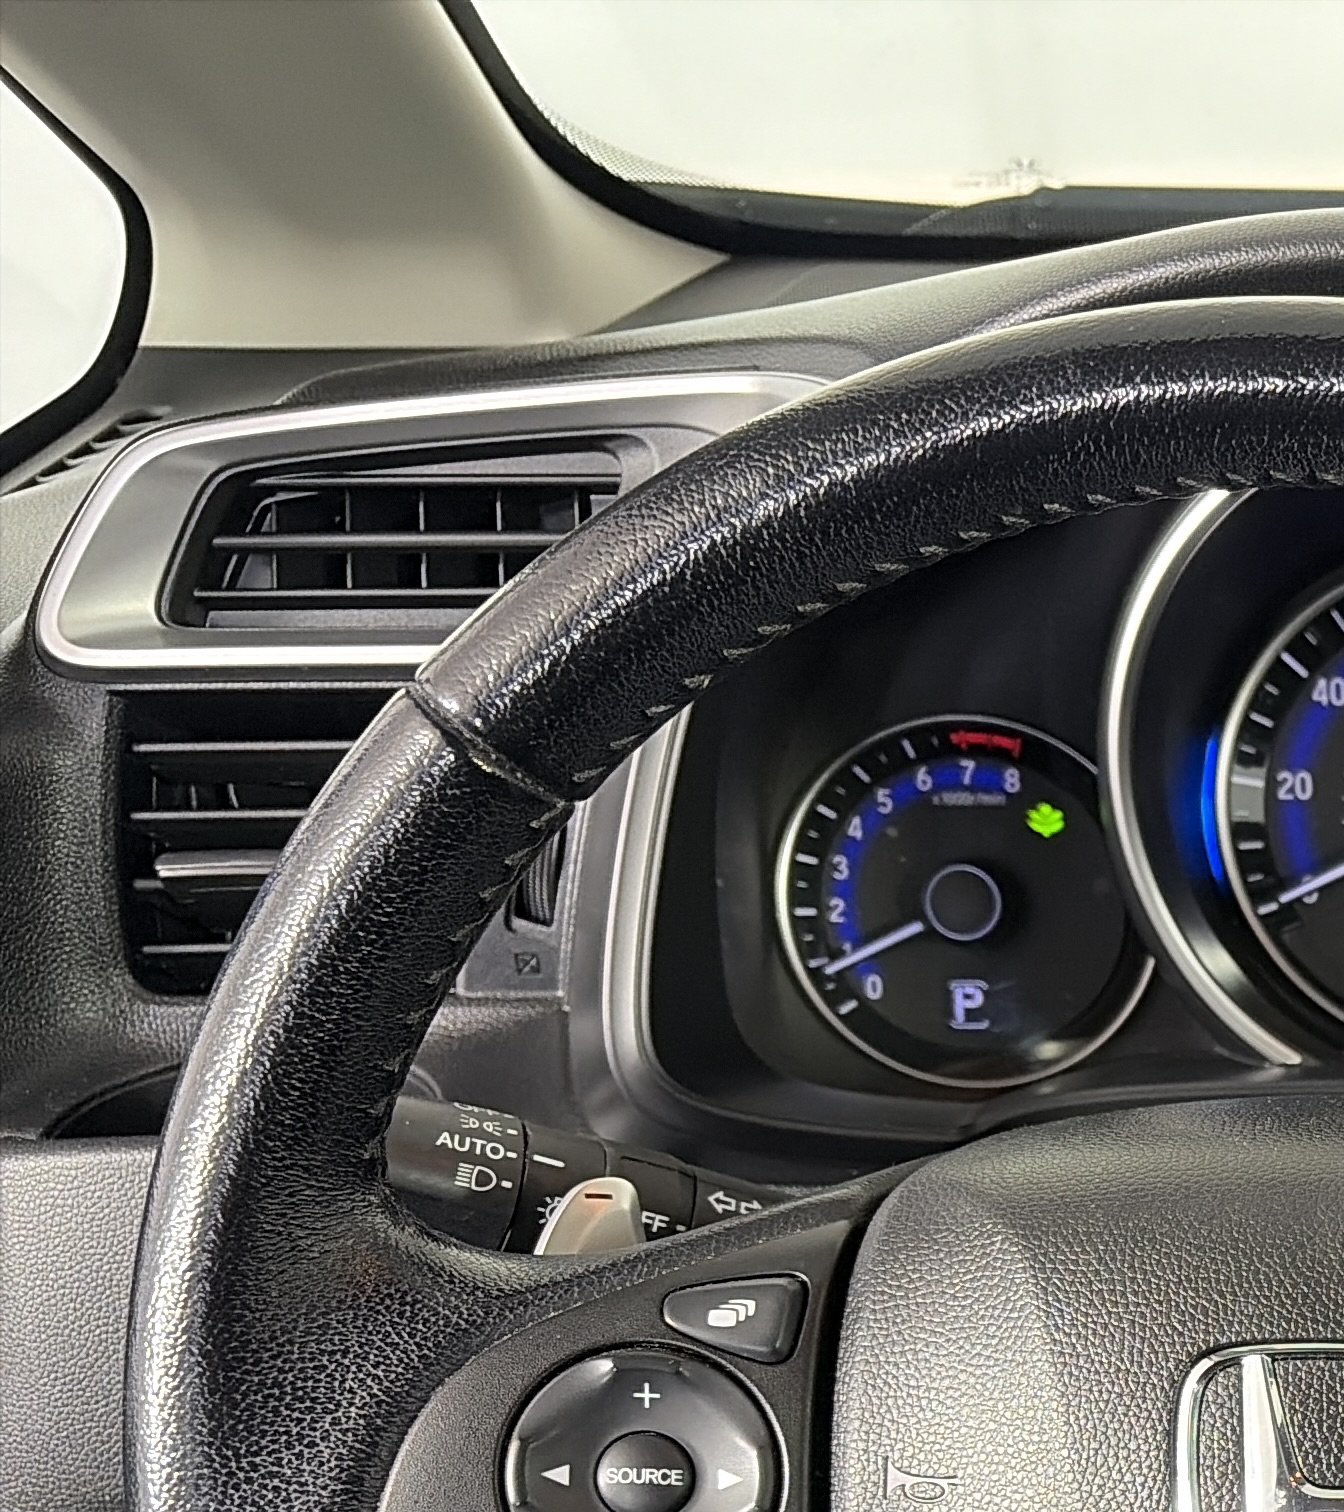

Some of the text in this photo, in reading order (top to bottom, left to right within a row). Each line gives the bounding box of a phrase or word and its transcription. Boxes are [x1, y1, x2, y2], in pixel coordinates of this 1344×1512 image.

[916, 766, 932, 792] 6
[959, 760, 976, 785] 7
[1004, 769, 1021, 792] 8
[1277, 771, 1313, 800] 20
[877, 787, 894, 815] 5
[847, 815, 863, 841] 4
[832, 854, 849, 881] 3
[828, 898, 846, 924] 2
[864, 974, 884, 1000] 0
[952, 986, 985, 1026] P
[435, 1131, 505, 1160] AUTO
[605, 1466, 685, 1487] SOURCE
